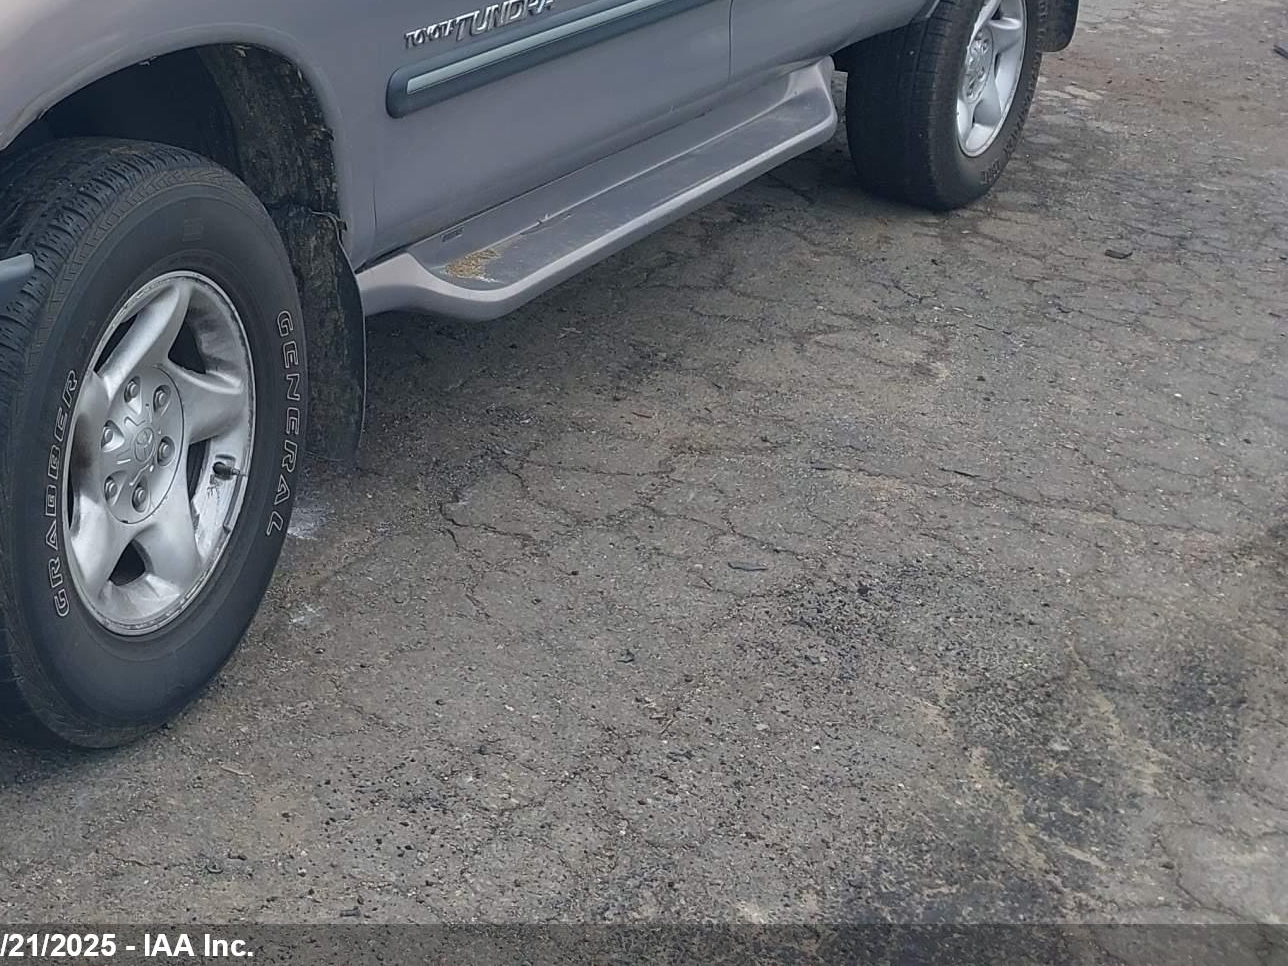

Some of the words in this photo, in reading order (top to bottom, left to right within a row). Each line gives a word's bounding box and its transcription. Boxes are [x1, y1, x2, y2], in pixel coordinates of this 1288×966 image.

[404, 17, 456, 49] TOYOTA
[43, 368, 79, 618] GRABBER
[266, 309, 300, 537] GENERAL
